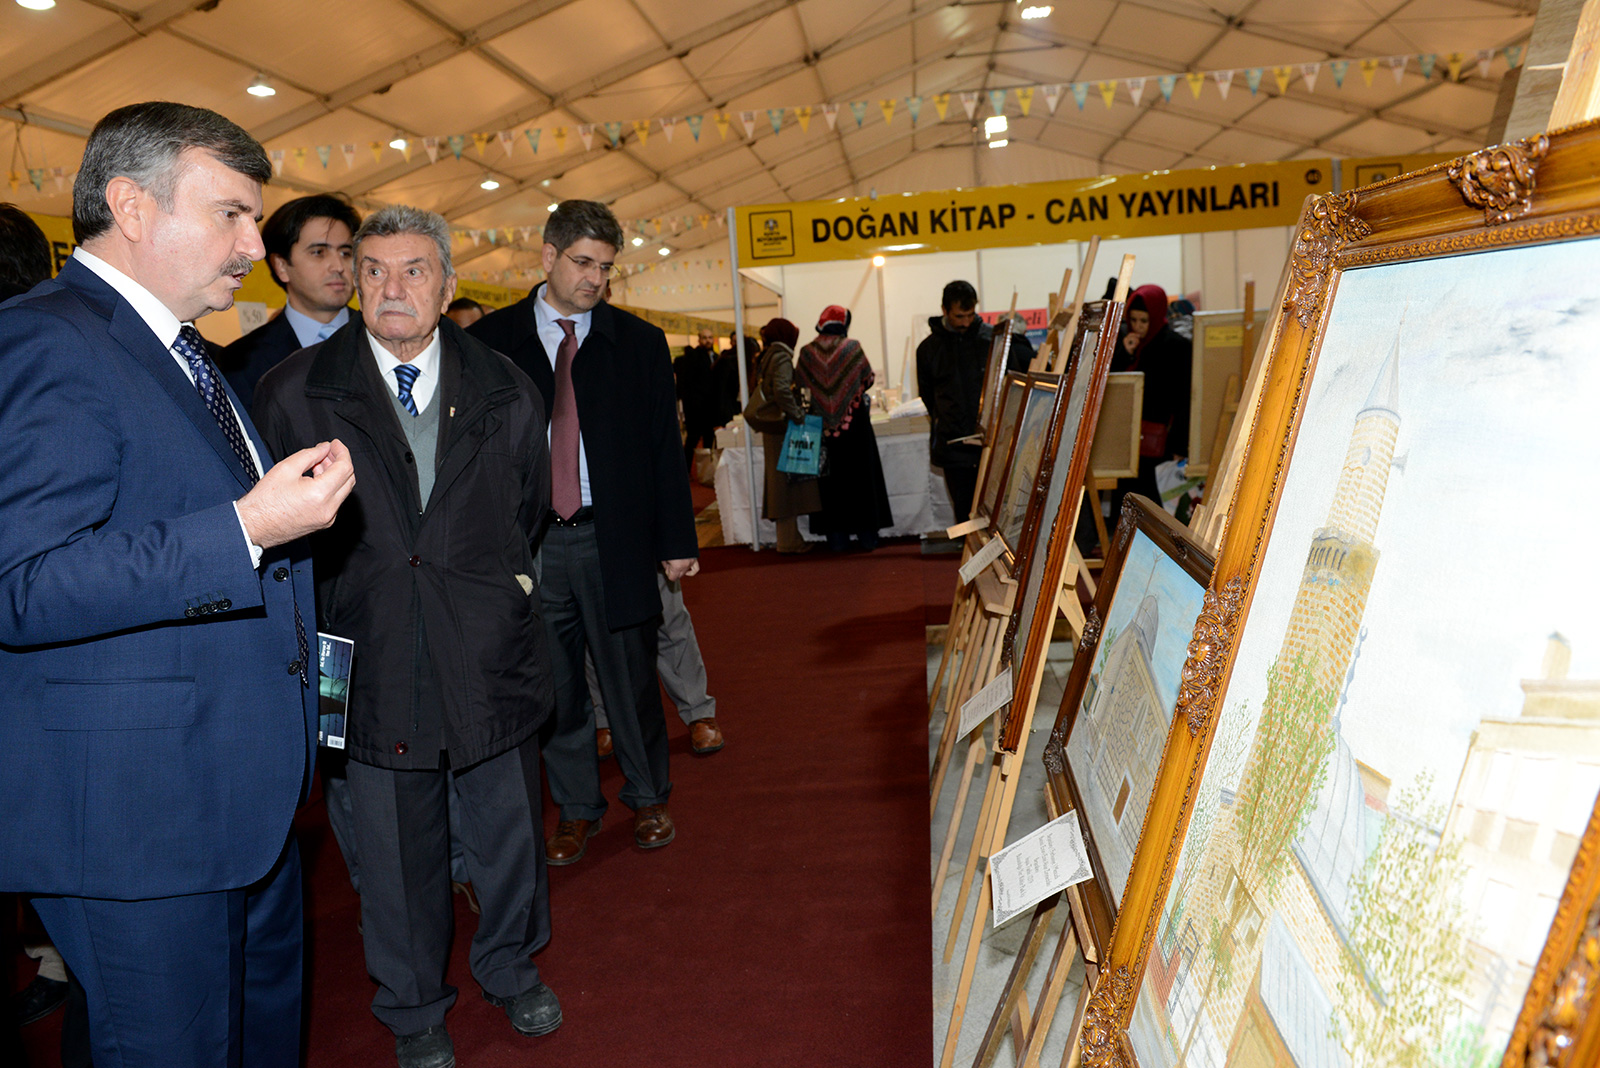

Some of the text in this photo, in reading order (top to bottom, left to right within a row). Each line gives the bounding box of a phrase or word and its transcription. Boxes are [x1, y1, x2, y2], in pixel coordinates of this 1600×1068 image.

[812, 207, 919, 243] DOĞAN
[930, 202, 1016, 234] KİTAP
[1045, 195, 1108, 225] CAN
[1119, 181, 1280, 218] YAYINLARI
